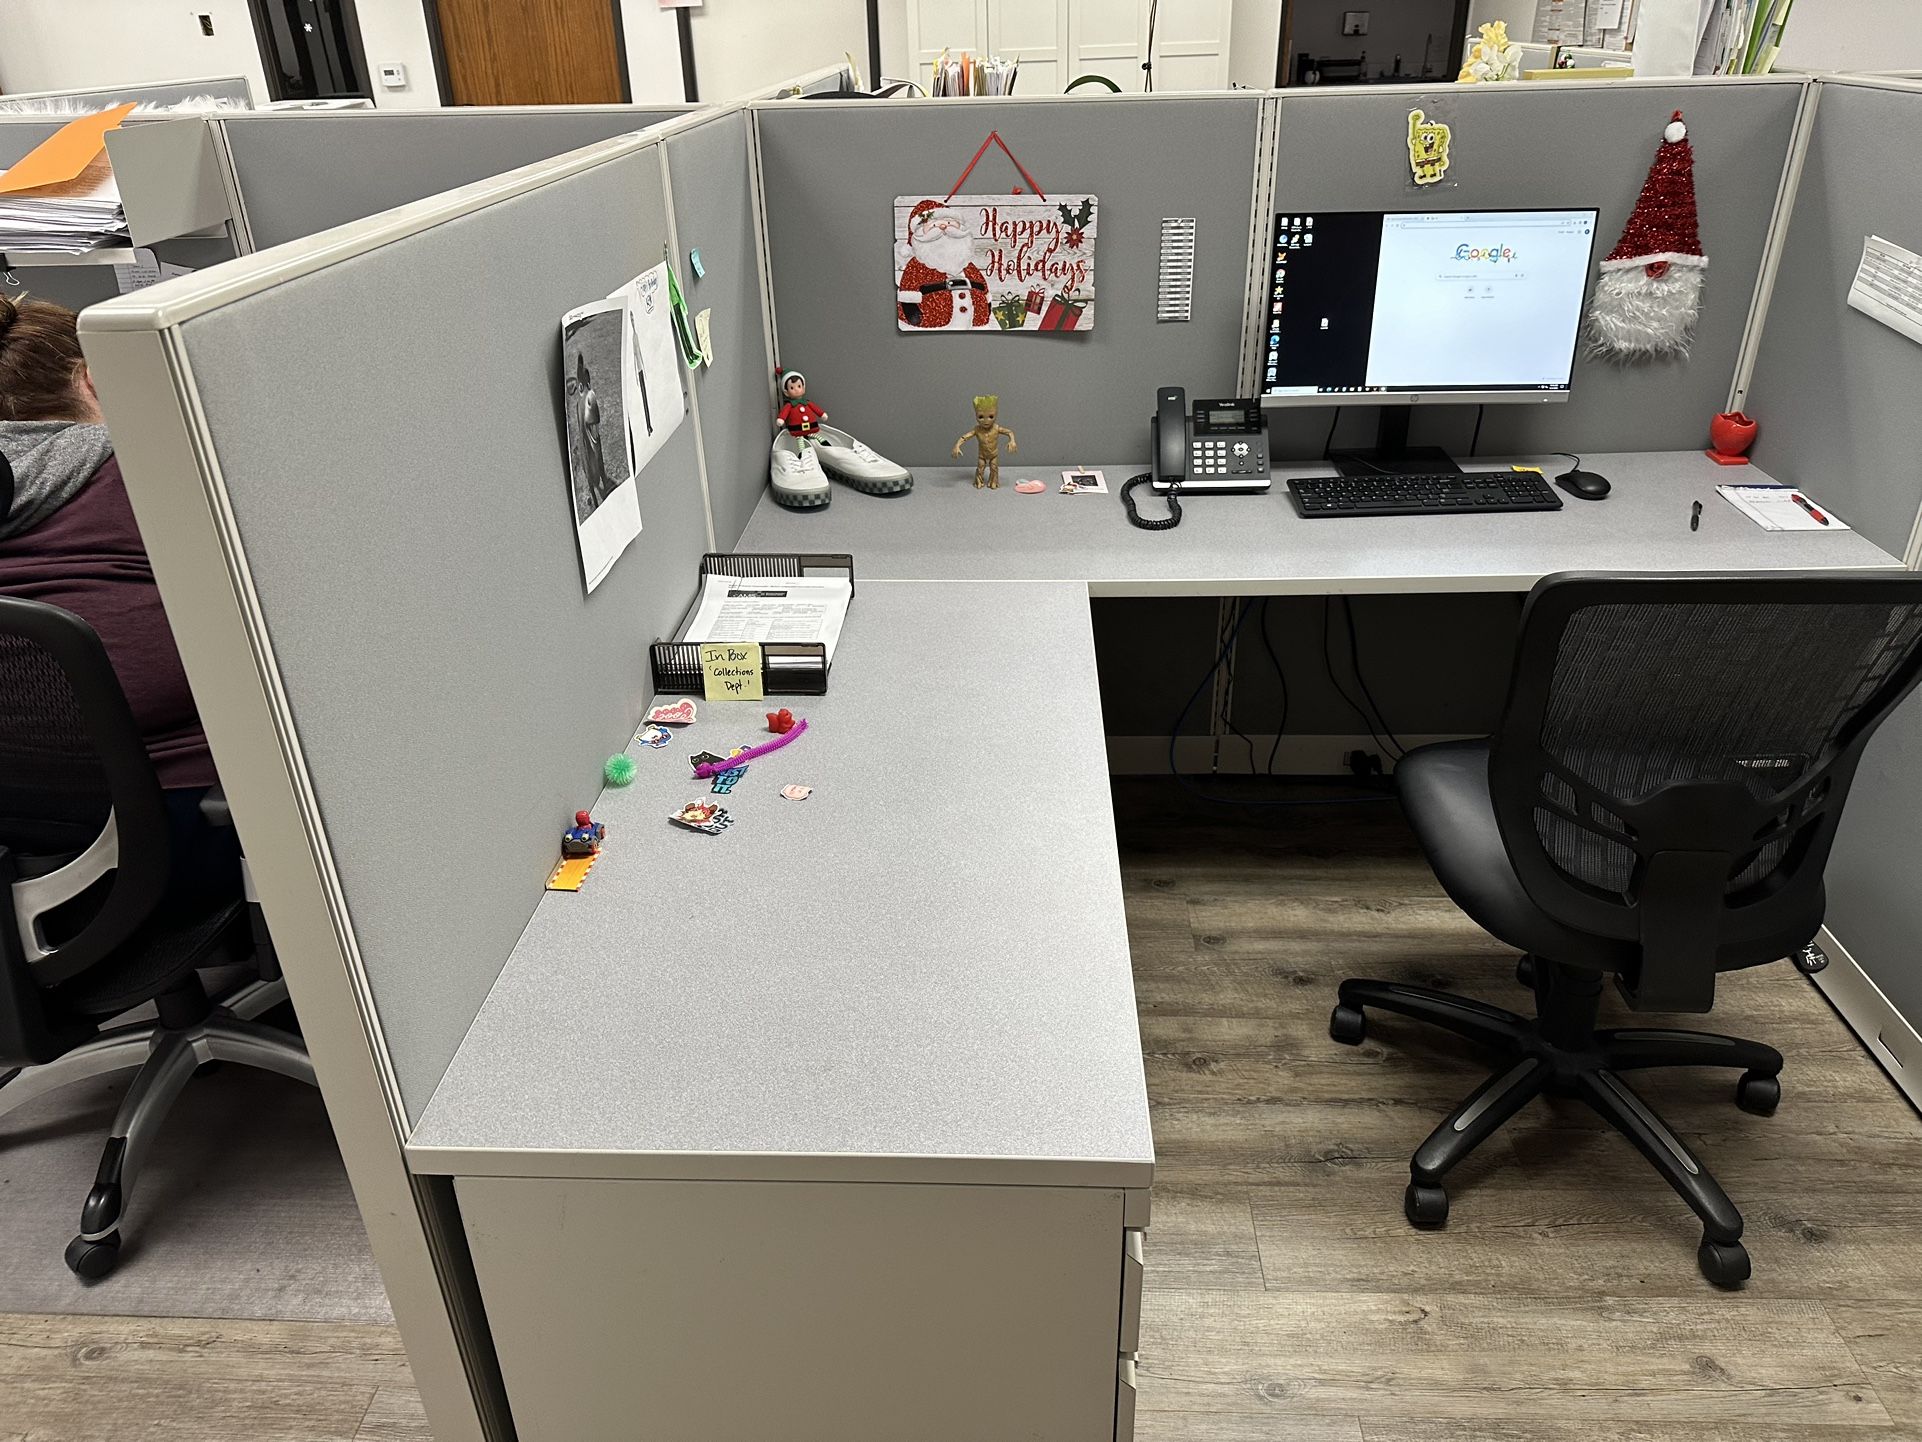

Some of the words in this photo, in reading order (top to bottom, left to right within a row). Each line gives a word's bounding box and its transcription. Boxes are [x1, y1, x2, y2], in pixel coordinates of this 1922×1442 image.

[979, 207, 1062, 252] Happy
[985, 243, 1090, 294] Holidays
[705, 649, 725, 662] In
[727, 648, 748, 661] Box
